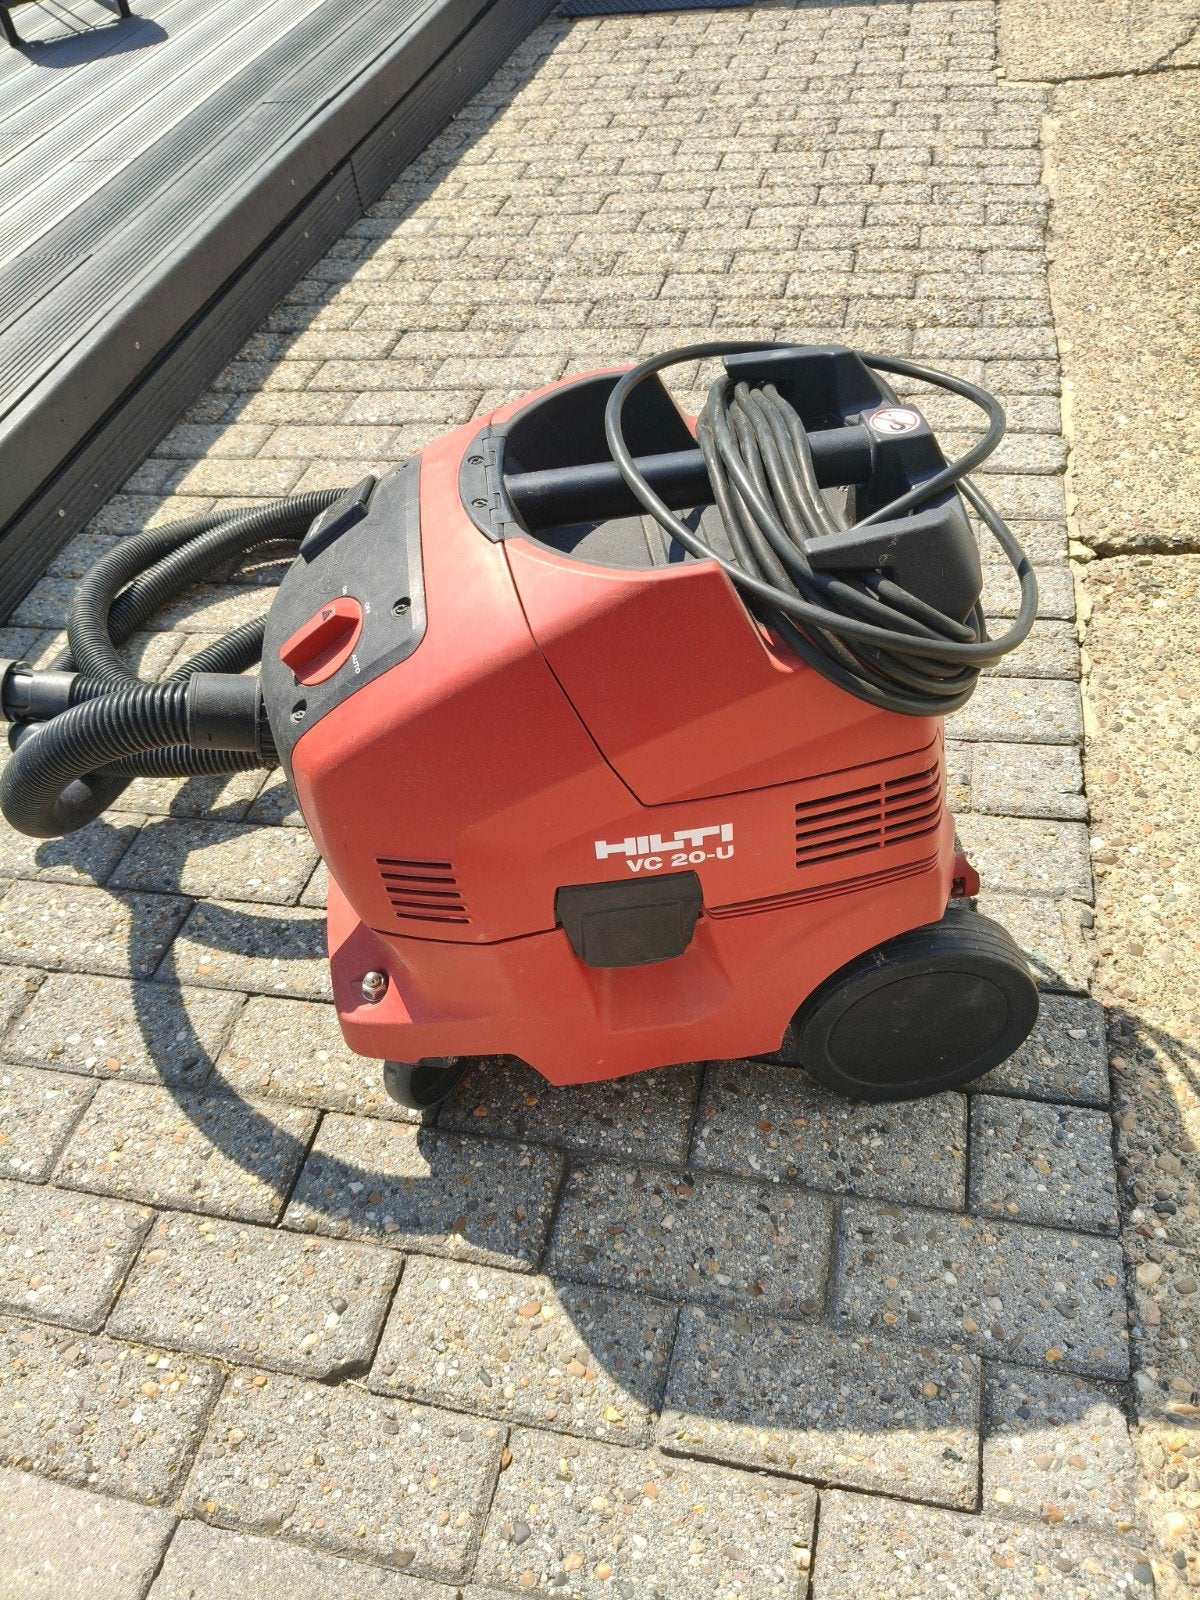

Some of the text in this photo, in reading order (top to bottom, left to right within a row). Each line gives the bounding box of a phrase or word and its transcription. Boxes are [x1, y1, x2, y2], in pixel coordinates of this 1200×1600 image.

[352, 654, 361, 674] AUTO
[594, 823, 734, 859] HILTI
[626, 845, 734, 873] VC 20-U
